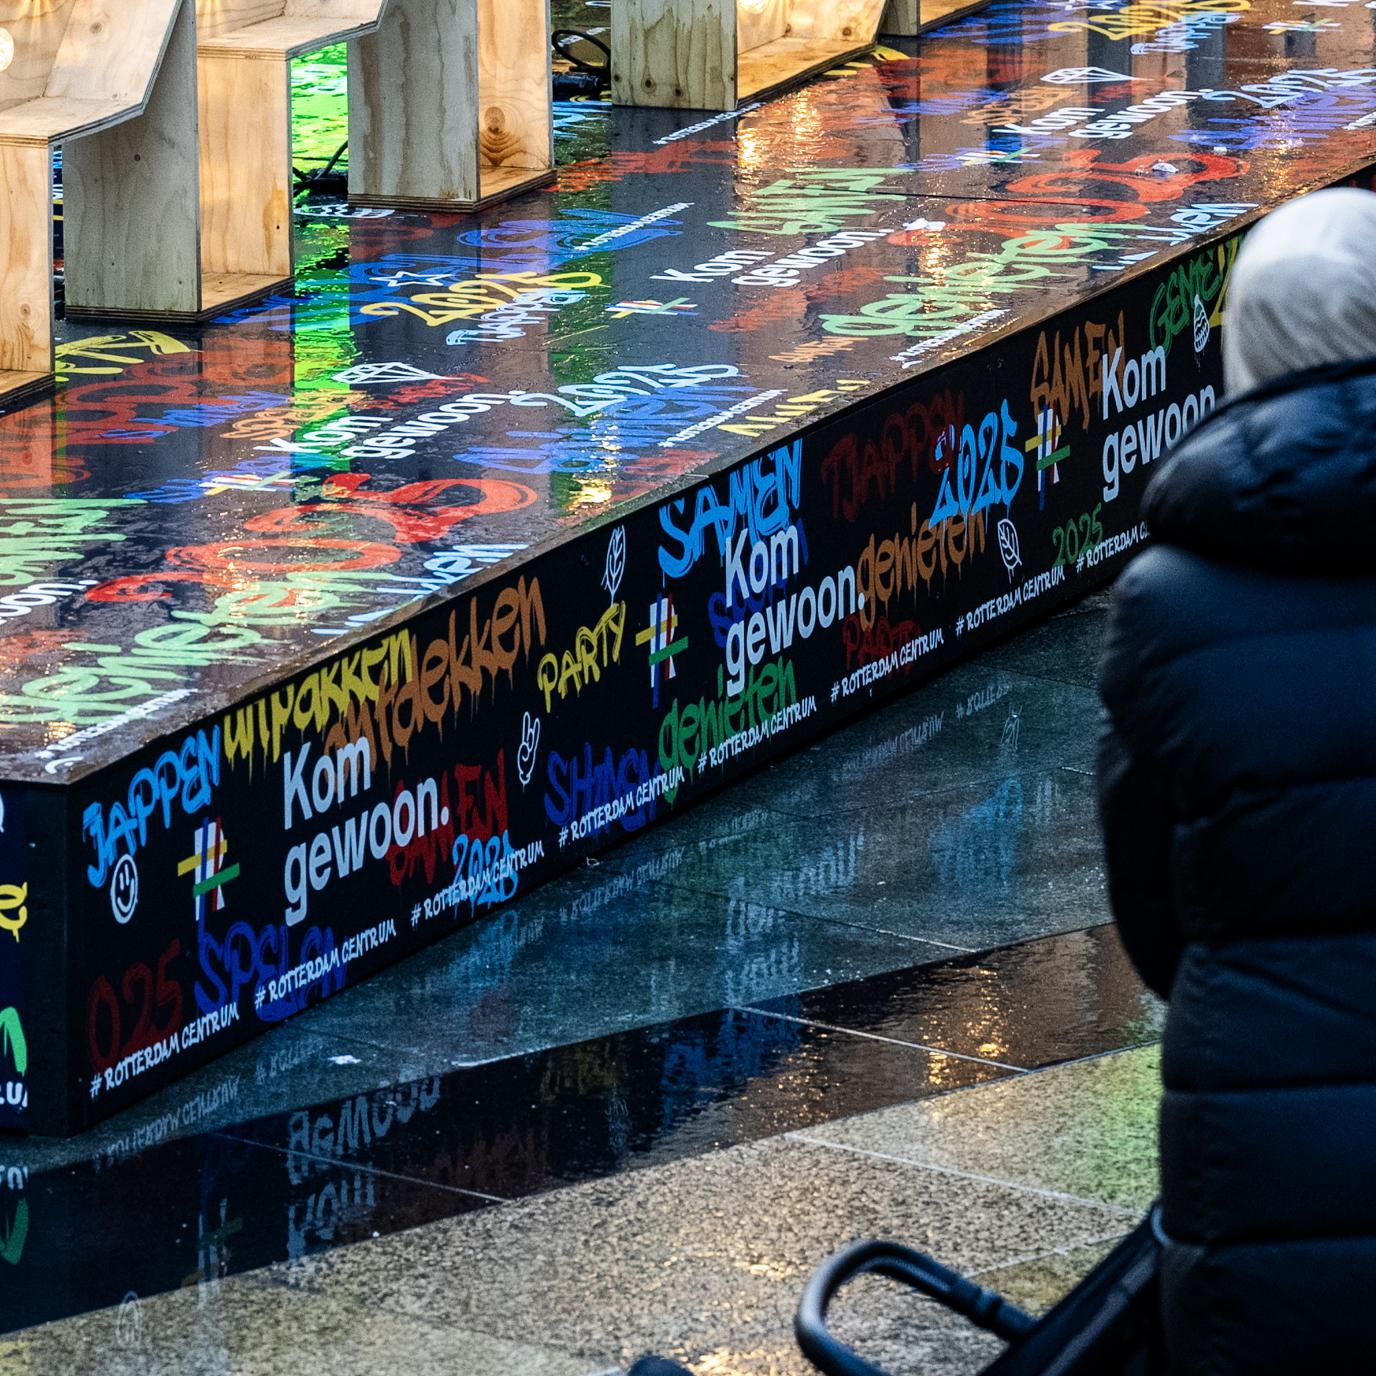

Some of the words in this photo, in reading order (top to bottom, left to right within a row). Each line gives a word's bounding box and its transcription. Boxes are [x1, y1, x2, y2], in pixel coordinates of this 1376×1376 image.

[987, 107, 1110, 134] Kom
[1056, 88, 1219, 138] gewoon.
[645, 249, 781, 282] Kom
[719, 228, 898, 286] gewoon.
[348, 271, 601, 326] 2025
[505, 364, 749, 416] 2025
[1102, 345, 1167, 421] Kom
[247, 415, 399, 453] Kom
[329, 390, 529, 458] gewoon.
[929, 398, 1025, 527] 2025
[658, 438, 804, 578] SAMEN
[1052, 503, 1104, 567] 2025
[73, 472, 530, 604] 2025
[726, 524, 799, 608] Kom
[1023, 566, 1066, 602] CENTRUM
[538, 600, 626, 712] PARTY
[726, 564, 865, 698] gewoon.
[900, 626, 944, 667] CENTRUM
[769, 696, 817, 738] CENTRUM
[283, 736, 372, 830] Kom
[635, 766, 685, 806] CENTRUM
[284, 776, 450, 927] gewoon.
[493, 840, 544, 883] CENTRUM
[341, 919, 396, 965] CENTRUM
[182, 1001, 240, 1051] CENTRUM
